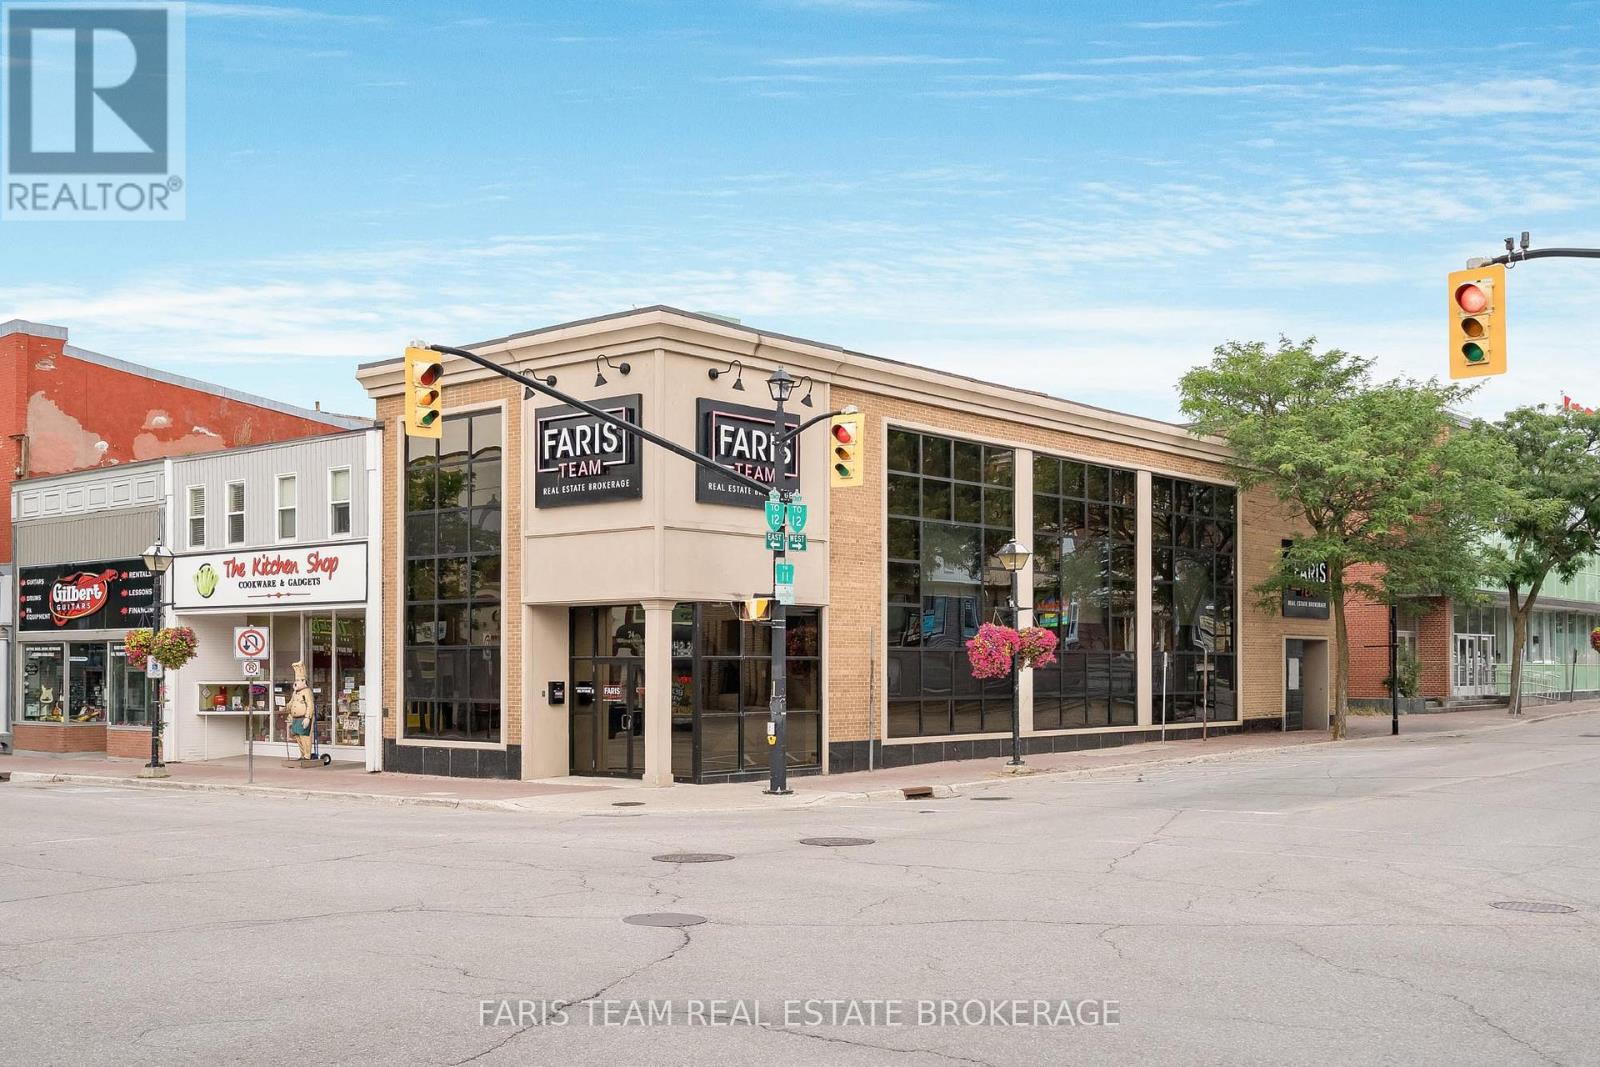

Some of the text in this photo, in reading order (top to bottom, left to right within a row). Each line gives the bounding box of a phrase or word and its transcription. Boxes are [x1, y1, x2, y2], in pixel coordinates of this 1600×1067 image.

[544, 422, 618, 460] FARIS
[558, 459, 601, 478] TEAM
[735, 462, 776, 483] TEAM
[543, 479, 630, 495] REAL ESTATE BROKERAGE
[708, 482, 752, 495] REAL ESTATE
[770, 503, 779, 511] TO
[793, 505, 802, 513] TO
[771, 515, 780, 525] 12
[792, 516, 802, 527] 12
[789, 535, 804, 543] WEST
[223, 551, 339, 580] The Kitchen Shop
[26, 578, 45, 586] GUITARS
[782, 571, 789, 582] 11
[238, 577, 321, 589] COOKWARE & GADGETS
[53, 583, 102, 603] Gilbert
[128, 588, 153, 596] LESSONS
[56, 602, 91, 611] GUITARS
[604, 686, 621, 695] FARIS
